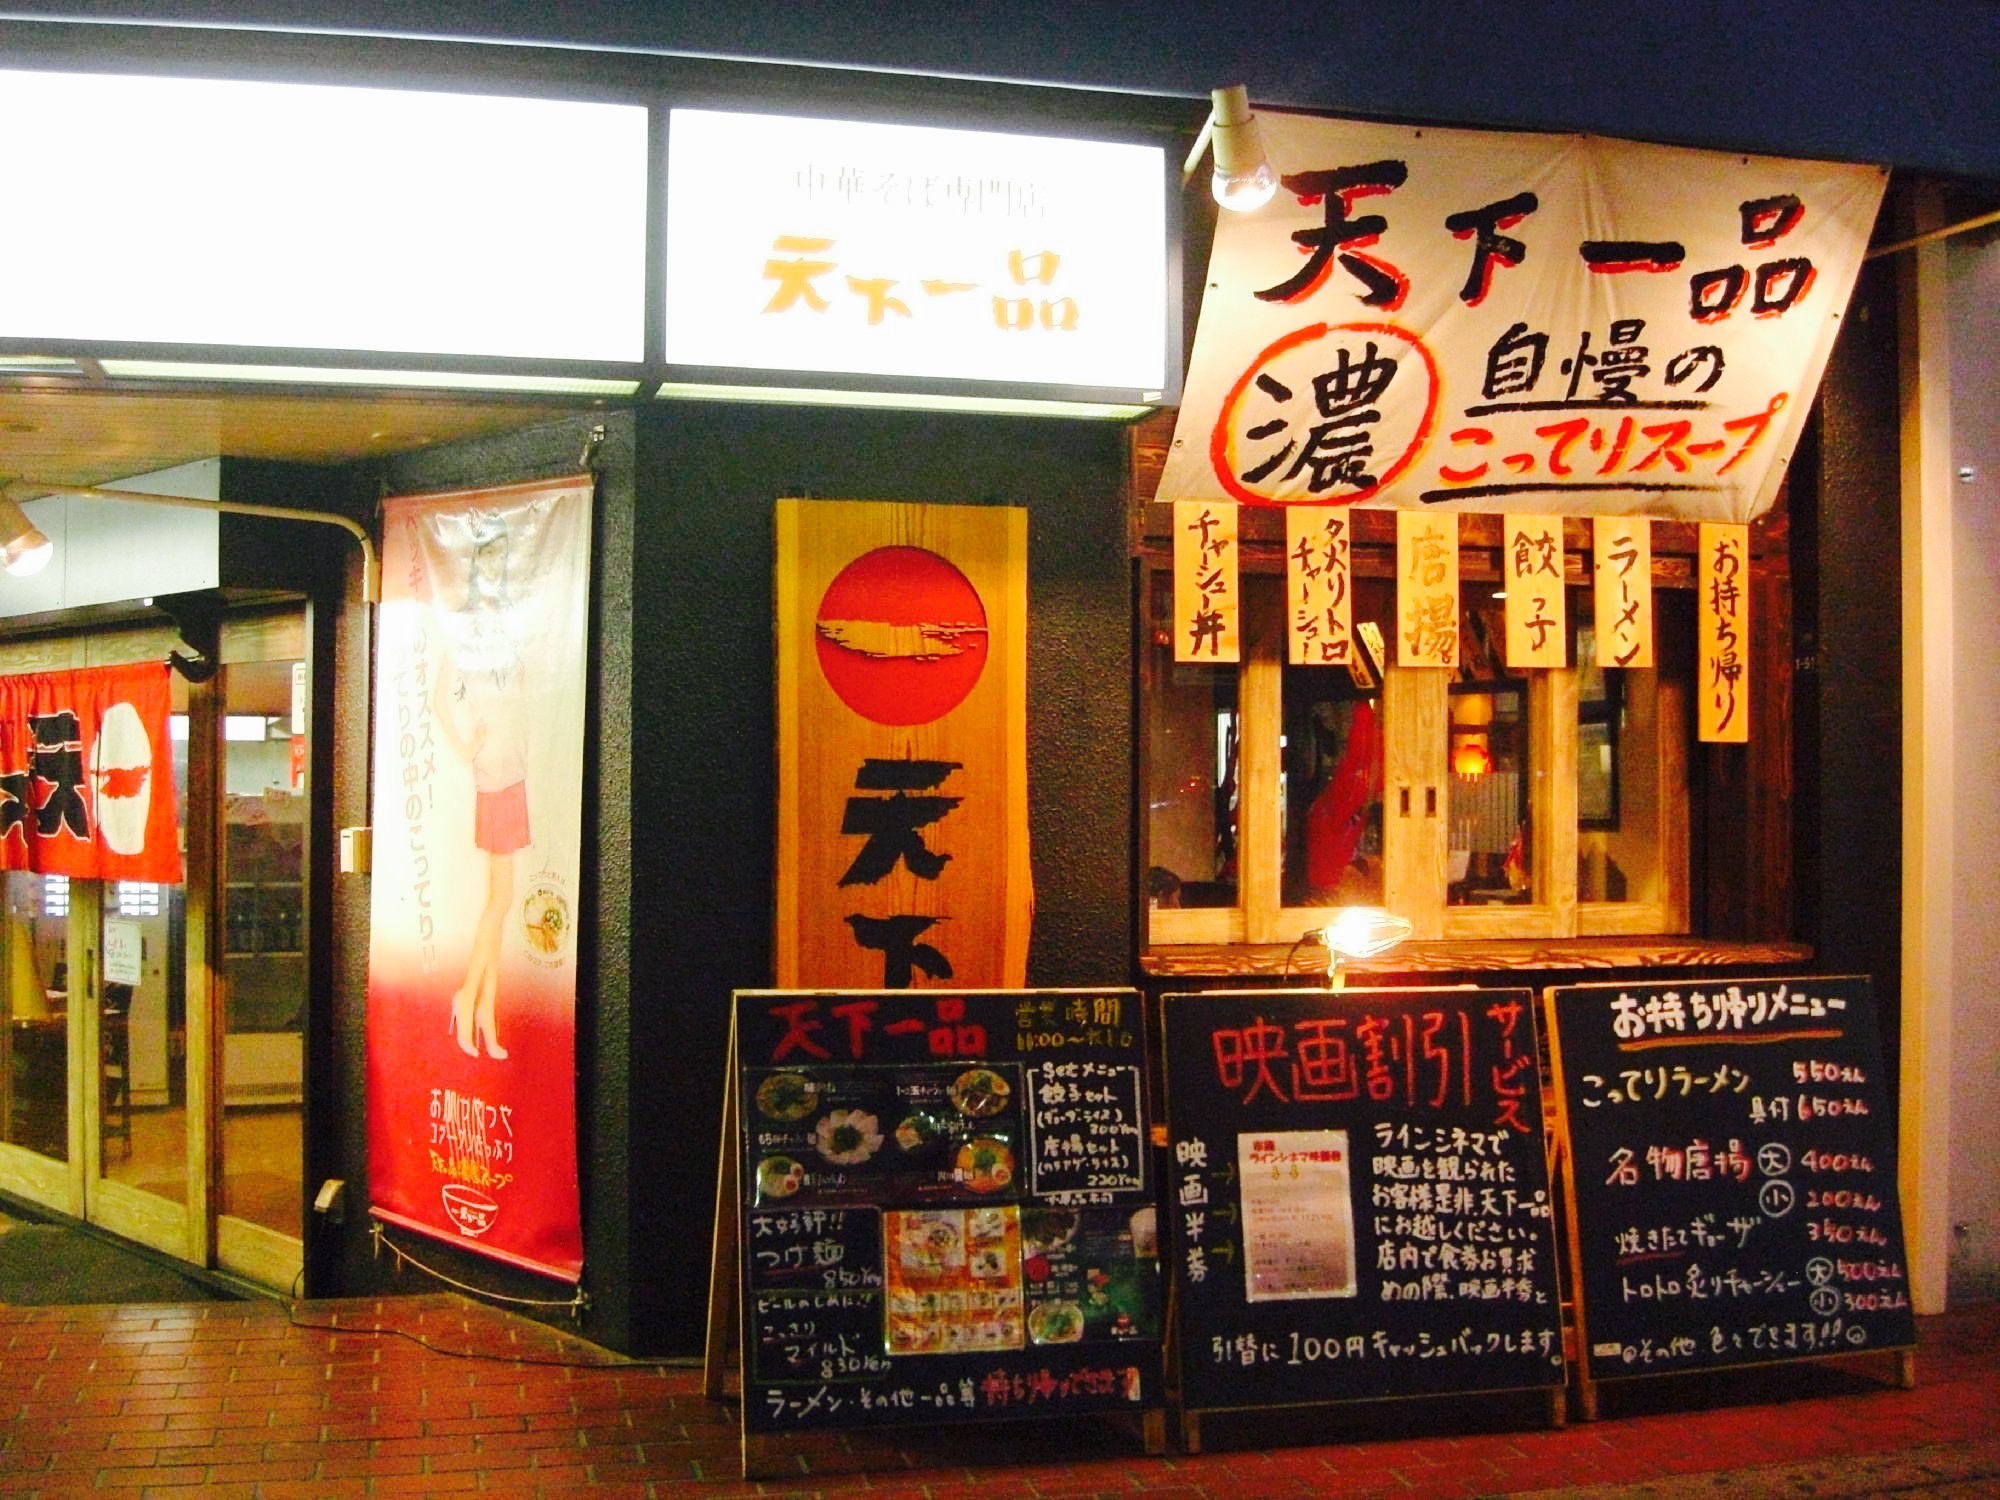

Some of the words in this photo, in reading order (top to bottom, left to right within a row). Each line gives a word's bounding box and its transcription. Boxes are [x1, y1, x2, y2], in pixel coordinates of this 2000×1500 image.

[1254, 160, 1818, 324] 天下一品
[760, 235, 1080, 332] 天下一品
[1480, 319, 1727, 402] 自慢の
[1240, 341, 1398, 492] 濃
[1440, 391, 1788, 480] こってりスープ
[1512, 530, 1560, 651] 餃子
[1608, 536, 1641, 666] ラーメン
[1710, 539, 1742, 734] お持ち帰り
[769, 999, 988, 1062] 天下一品
[1015, 998, 1120, 1028] 営業時間
[1611, 985, 1846, 1038] お持ち帰りメニュー
[1212, 1013, 1472, 1106] 映画割引
[1487, 1001, 1531, 1133] サービス
[1582, 1065, 1750, 1107] こってりラーメン
[1793, 1060, 1866, 1084] 550えん
[1373, 1122, 1510, 1156] ラインシネマで
[1798, 1095, 1869, 1121] 650えん
[1372, 1155, 1515, 1183] 映画を観られた
[1606, 1138, 1752, 1186] 名物唐揚
[1801, 1150, 1874, 1173] 400えん
[1175, 1136, 1208, 1282] 映画半券
[1374, 1214, 1538, 1242] にお越しください。
[1806, 1219, 1887, 1246] 350えん
[757, 1238, 844, 1268] つけ麺
